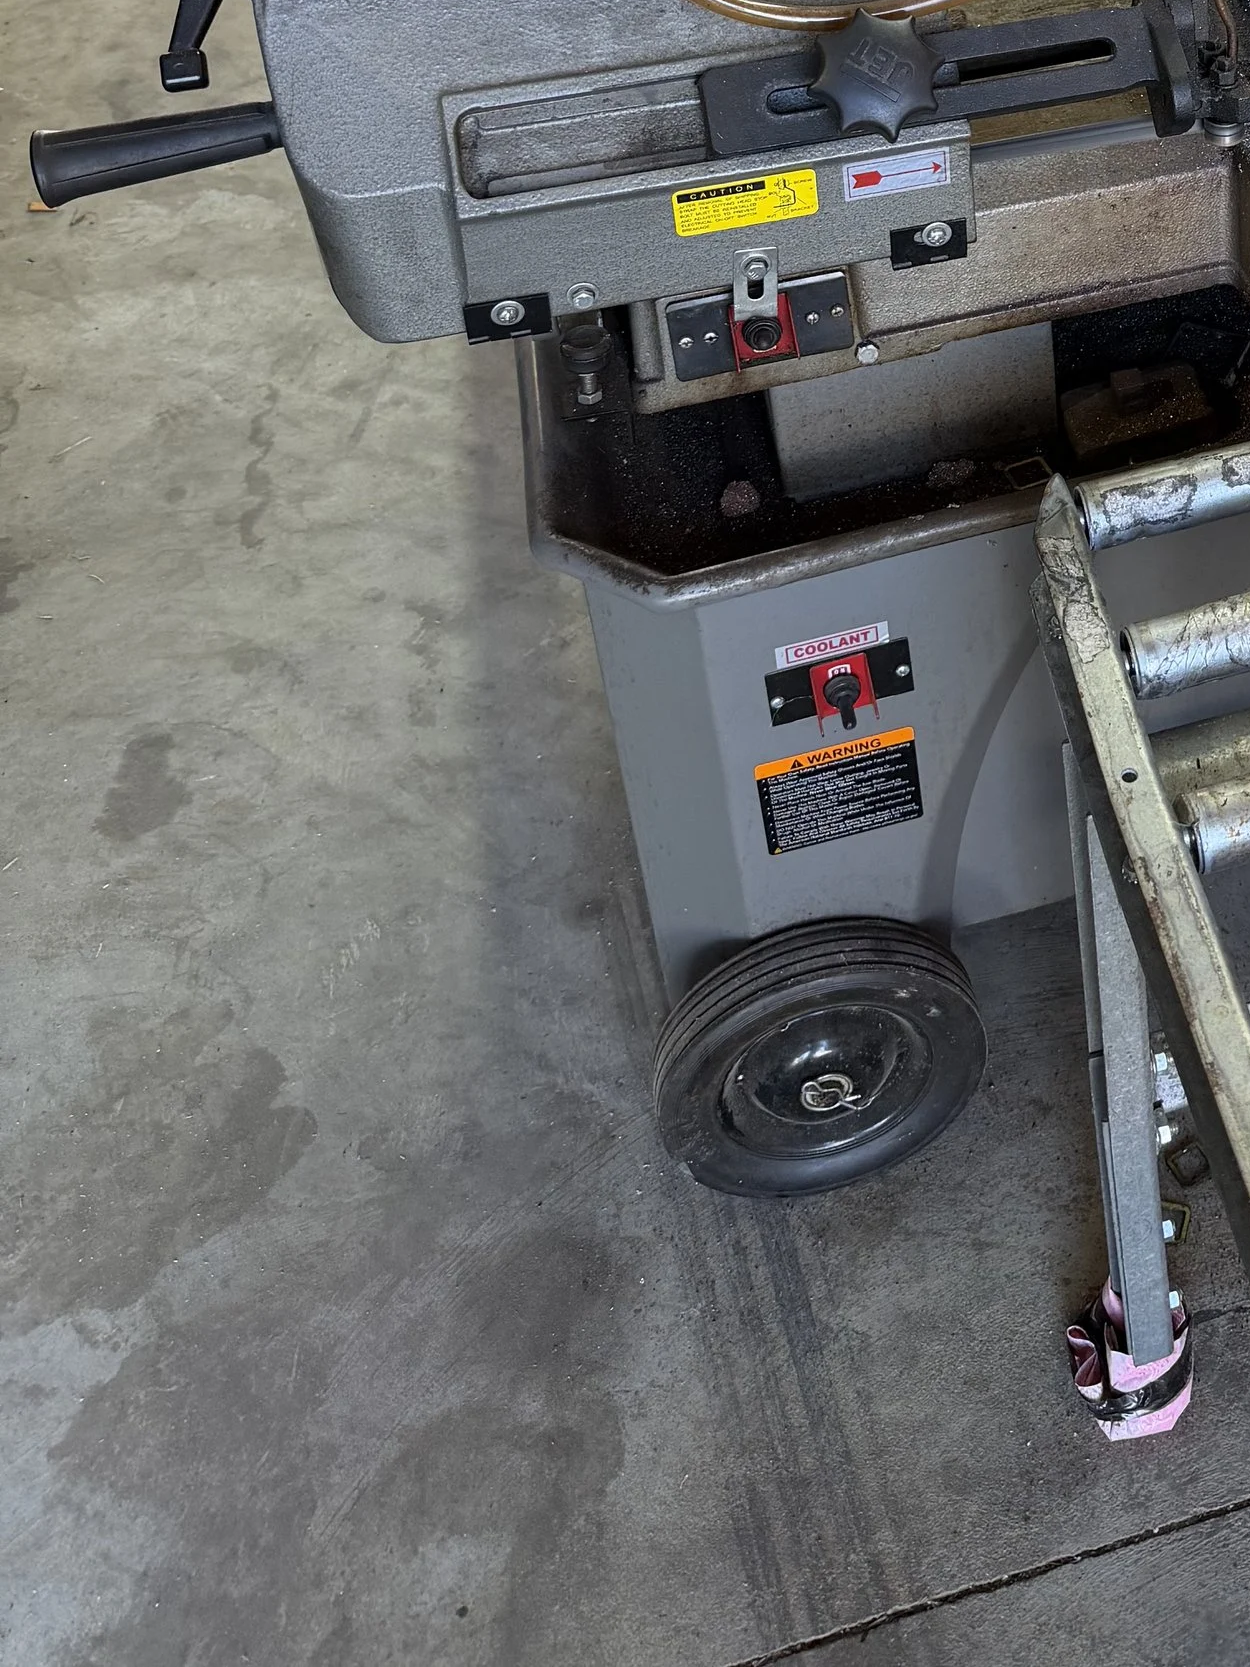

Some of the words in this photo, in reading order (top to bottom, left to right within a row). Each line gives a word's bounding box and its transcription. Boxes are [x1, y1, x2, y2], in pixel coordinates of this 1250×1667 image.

[847, 36, 914, 87] JET
[690, 184, 753, 200] CAUTION
[793, 630, 872, 659] COOLANT
[832, 667, 848, 676] ON
[807, 737, 881, 764] WARNING
